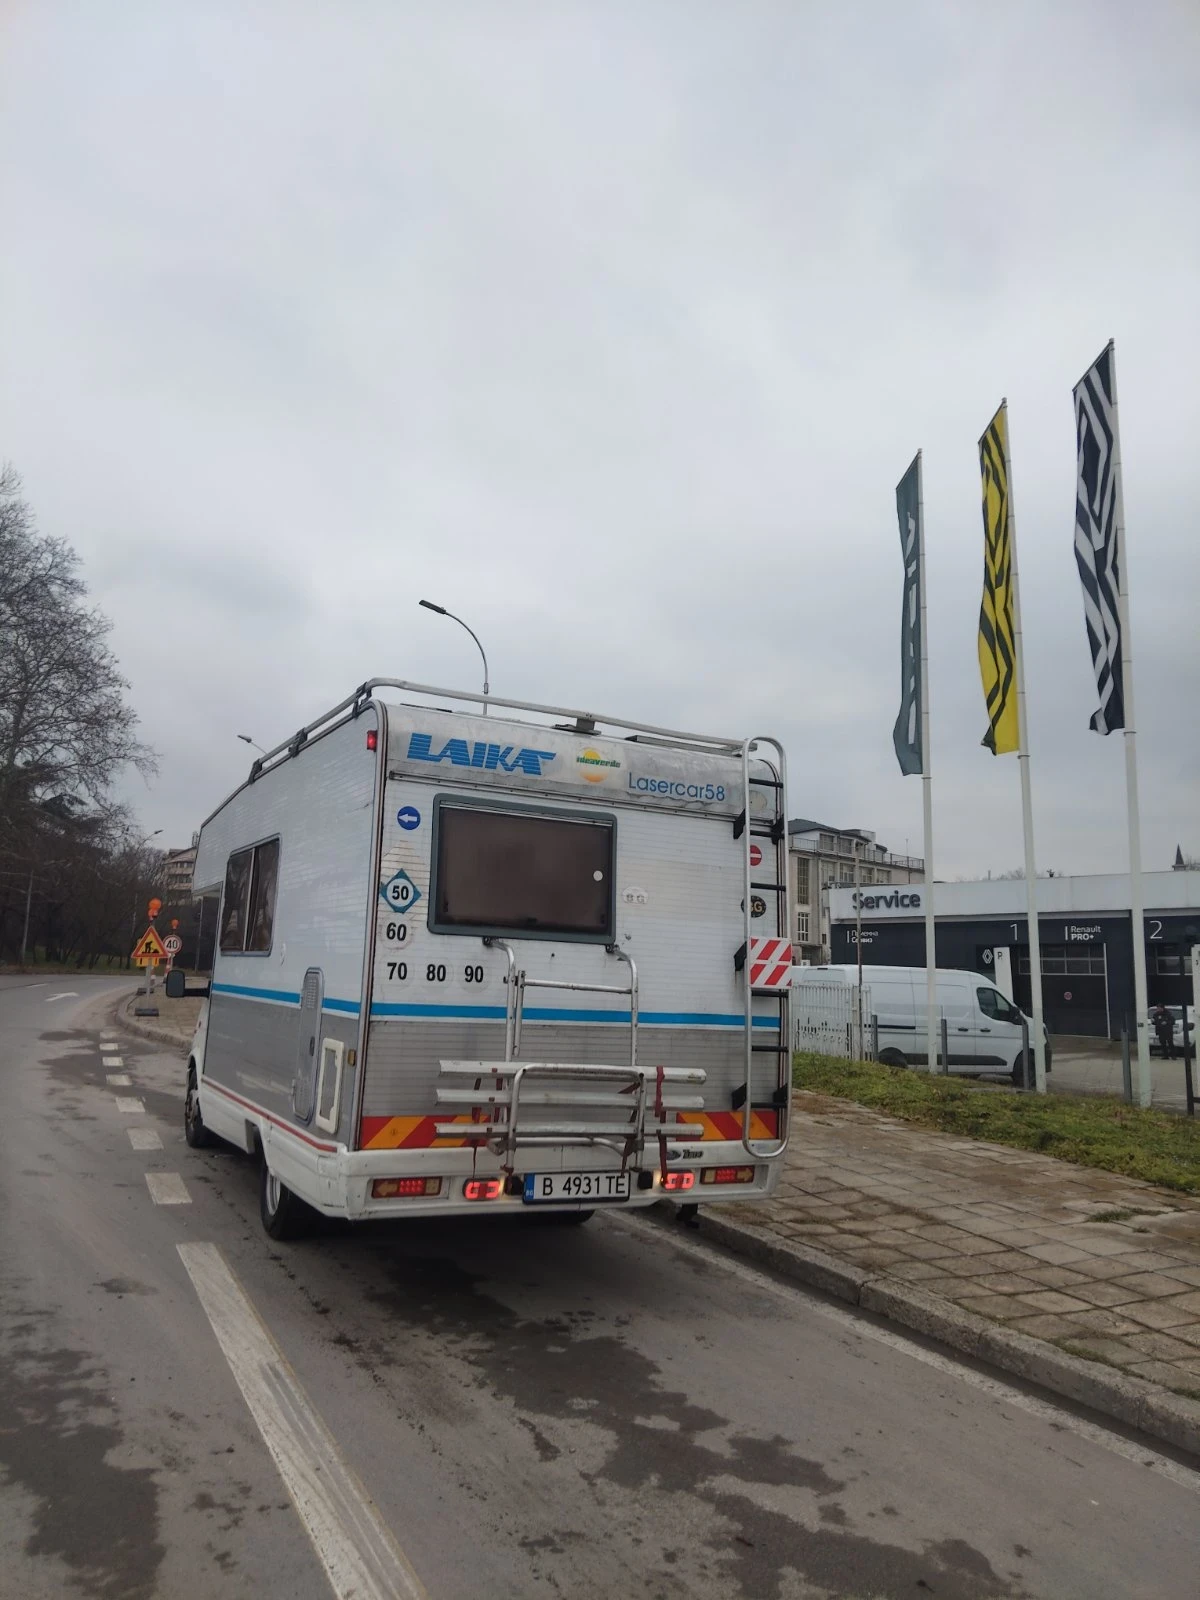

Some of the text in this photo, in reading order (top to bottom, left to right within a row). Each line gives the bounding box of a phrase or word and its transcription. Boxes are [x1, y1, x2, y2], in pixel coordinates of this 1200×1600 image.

[407, 732, 556, 775] LAIKA
[628, 772, 725, 801] Lasercar58
[392, 885, 409, 900] 50
[852, 890, 921, 910] Service
[386, 922, 407, 941] 60
[1009, 923, 1018, 941] 1
[1071, 925, 1101, 933] Renault
[1071, 933, 1094, 941] PRO+
[1149, 920, 1163, 940] 2
[166, 939, 178, 949] 40
[387, 962, 484, 983] 70 80 90
[543, 1175, 625, 1196] B 4931 TE
